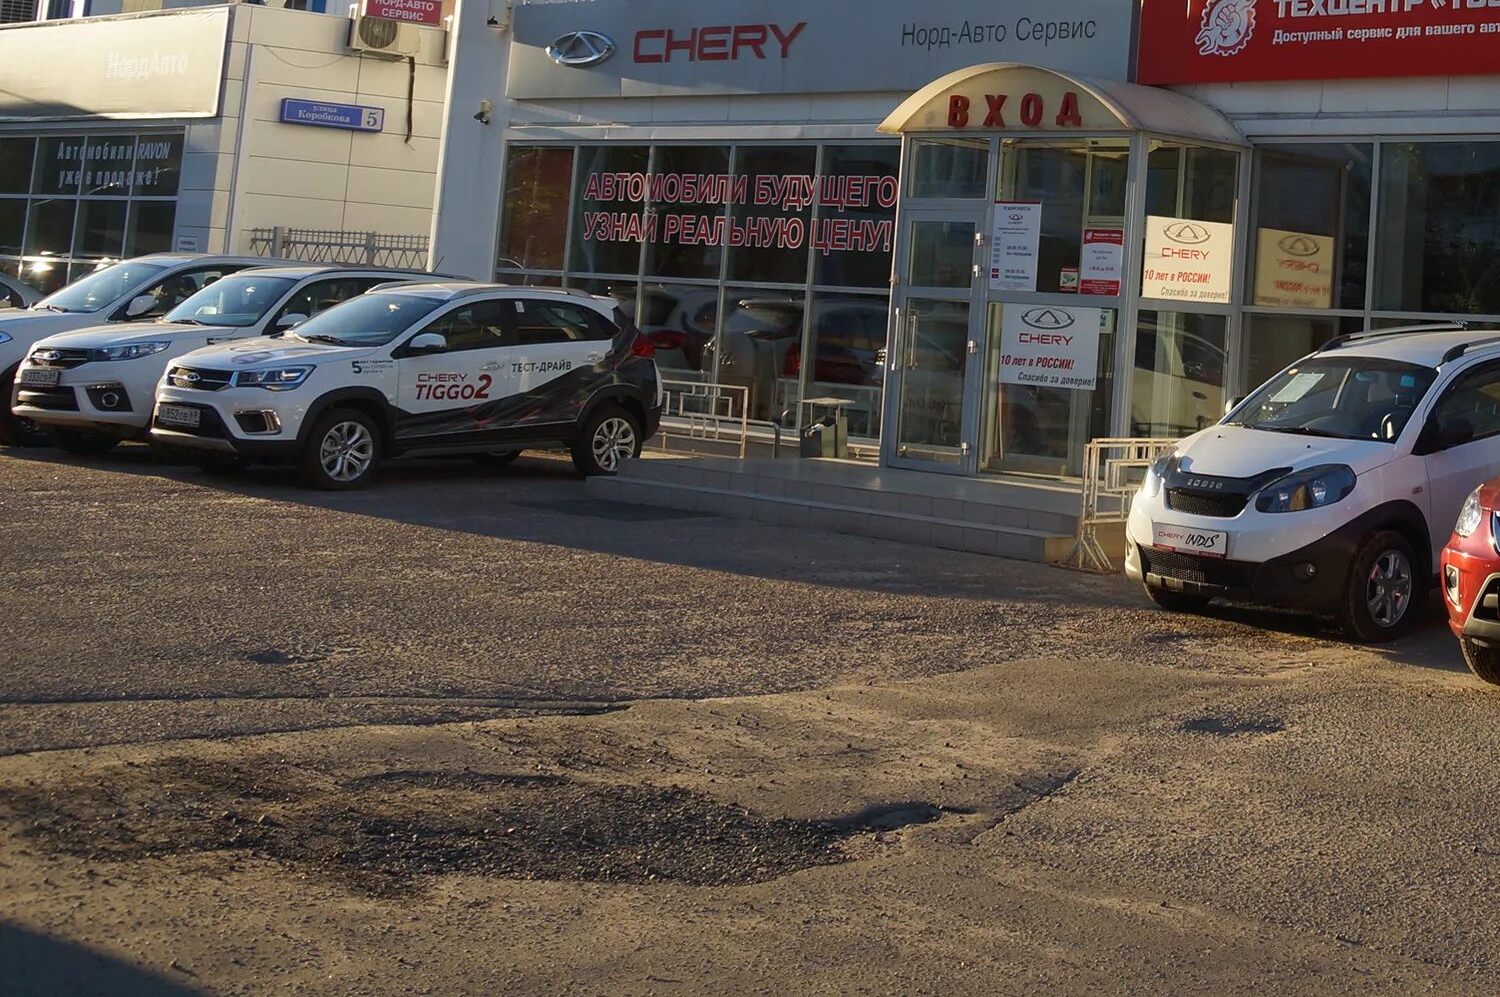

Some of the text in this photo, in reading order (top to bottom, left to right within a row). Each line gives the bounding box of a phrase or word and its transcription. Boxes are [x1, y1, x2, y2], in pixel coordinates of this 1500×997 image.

[381, 8, 424, 22] СЕРВИС
[901, 17, 1097, 51] Норд-Авто Сервис
[1272, 26, 1343, 45] Доступный
[1346, 25, 1392, 42] сервис
[1396, 24, 1422, 39] для
[1425, 21, 1476, 37] вашего
[633, 22, 808, 63] CHERY
[297, 109, 350, 123] Коробкова
[312, 105, 338, 113] улица
[948, 92, 1082, 128] ВХОД
[366, 112, 378, 127] 5
[57, 141, 171, 160] Автомобили RAVON
[58, 170, 81, 189] уже
[85, 171, 92, 186] в
[584, 172, 899, 212] АВТОМОБИЛИ БУДУЩЕГО
[583, 207, 892, 256] УЗНАЙ РЕАЛЬНУЮ ЦЕНУ!
[1161, 247, 1211, 260] CHERY
[1144, 269, 1154, 280] 10
[1155, 272, 1168, 281] лет
[1177, 270, 1211, 284] РОССИИ!
[1160, 286, 1228, 300] Спасибо за доверие!
[1019, 333, 1074, 346] CHERY
[511, 359, 572, 373] ТЕСТ-ДРАЙВ
[1001, 354, 1010, 365] 10
[1011, 358, 1026, 366] лет
[1035, 357, 1075, 370] РОССИИ!
[417, 373, 468, 383] CHERY
[1017, 372, 1049, 383] Спасибо
[1050, 376, 1059, 384] за
[1158, 531, 1185, 540] CHERY
[1185, 533, 1220, 548] INDIS
